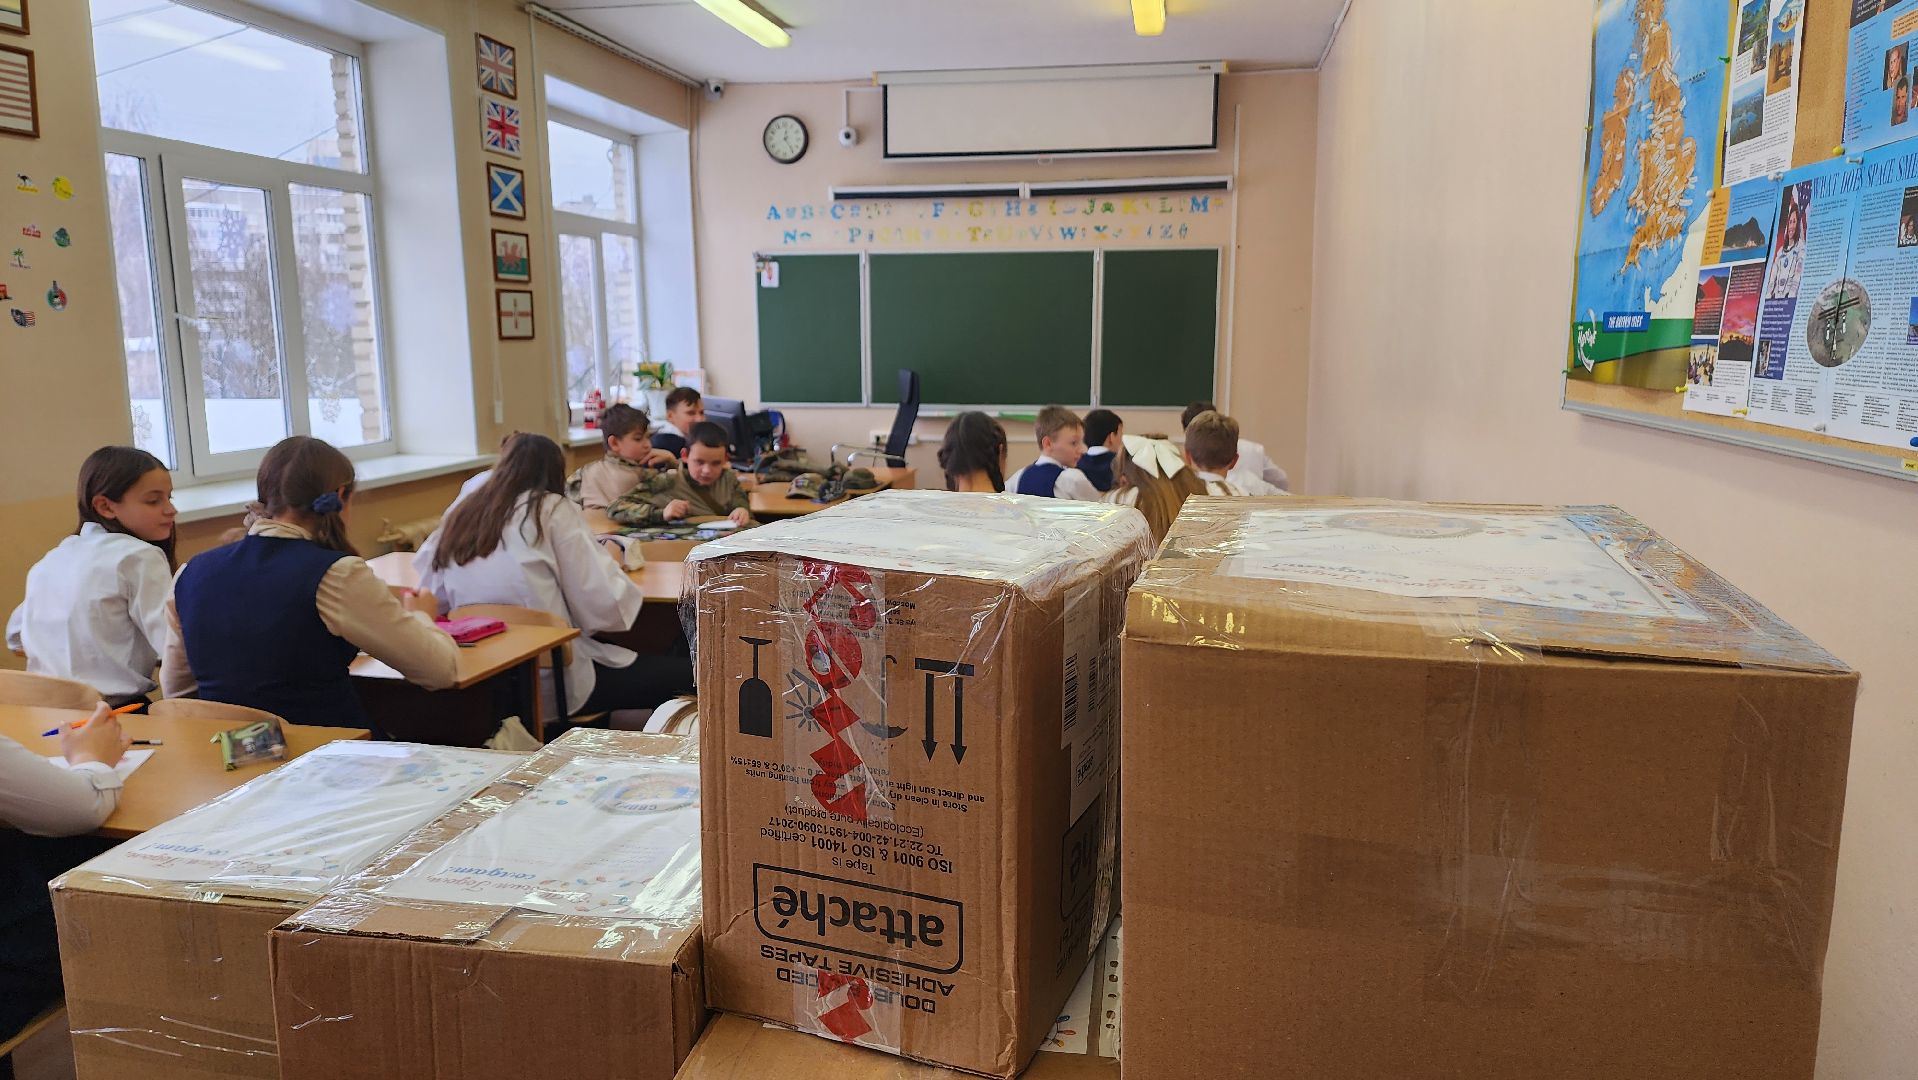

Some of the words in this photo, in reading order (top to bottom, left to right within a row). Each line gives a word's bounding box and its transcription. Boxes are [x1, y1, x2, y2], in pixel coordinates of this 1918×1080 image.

[1813, 173, 1839, 199] WHAT
[1840, 167, 1865, 194] DOES
[1868, 158, 1896, 188] SPACE
[745, 768, 766, 779] units
[768, 772, 799, 785] heating
[896, 782, 916, 793] light
[919, 785, 936, 795] sun
[938, 788, 965, 800] direct
[889, 790, 902, 801] dry
[904, 794, 929, 805] clean
[968, 793, 985, 803] and
[932, 799, 940, 809] in
[784, 805, 827, 820] product)
[760, 827, 806, 844] certified
[811, 836, 847, 853] 14001
[851, 843, 875, 858] ISO
[879, 848, 889, 861] &
[893, 851, 924, 868] 9001
[831, 856, 841, 868] is
[845, 858, 875, 875] Tape
[928, 857, 953, 873] ISO
[771, 885, 945, 950] attaché
[760, 944, 832, 972] TAPES
[838, 959, 956, 997] ADHESIVE
